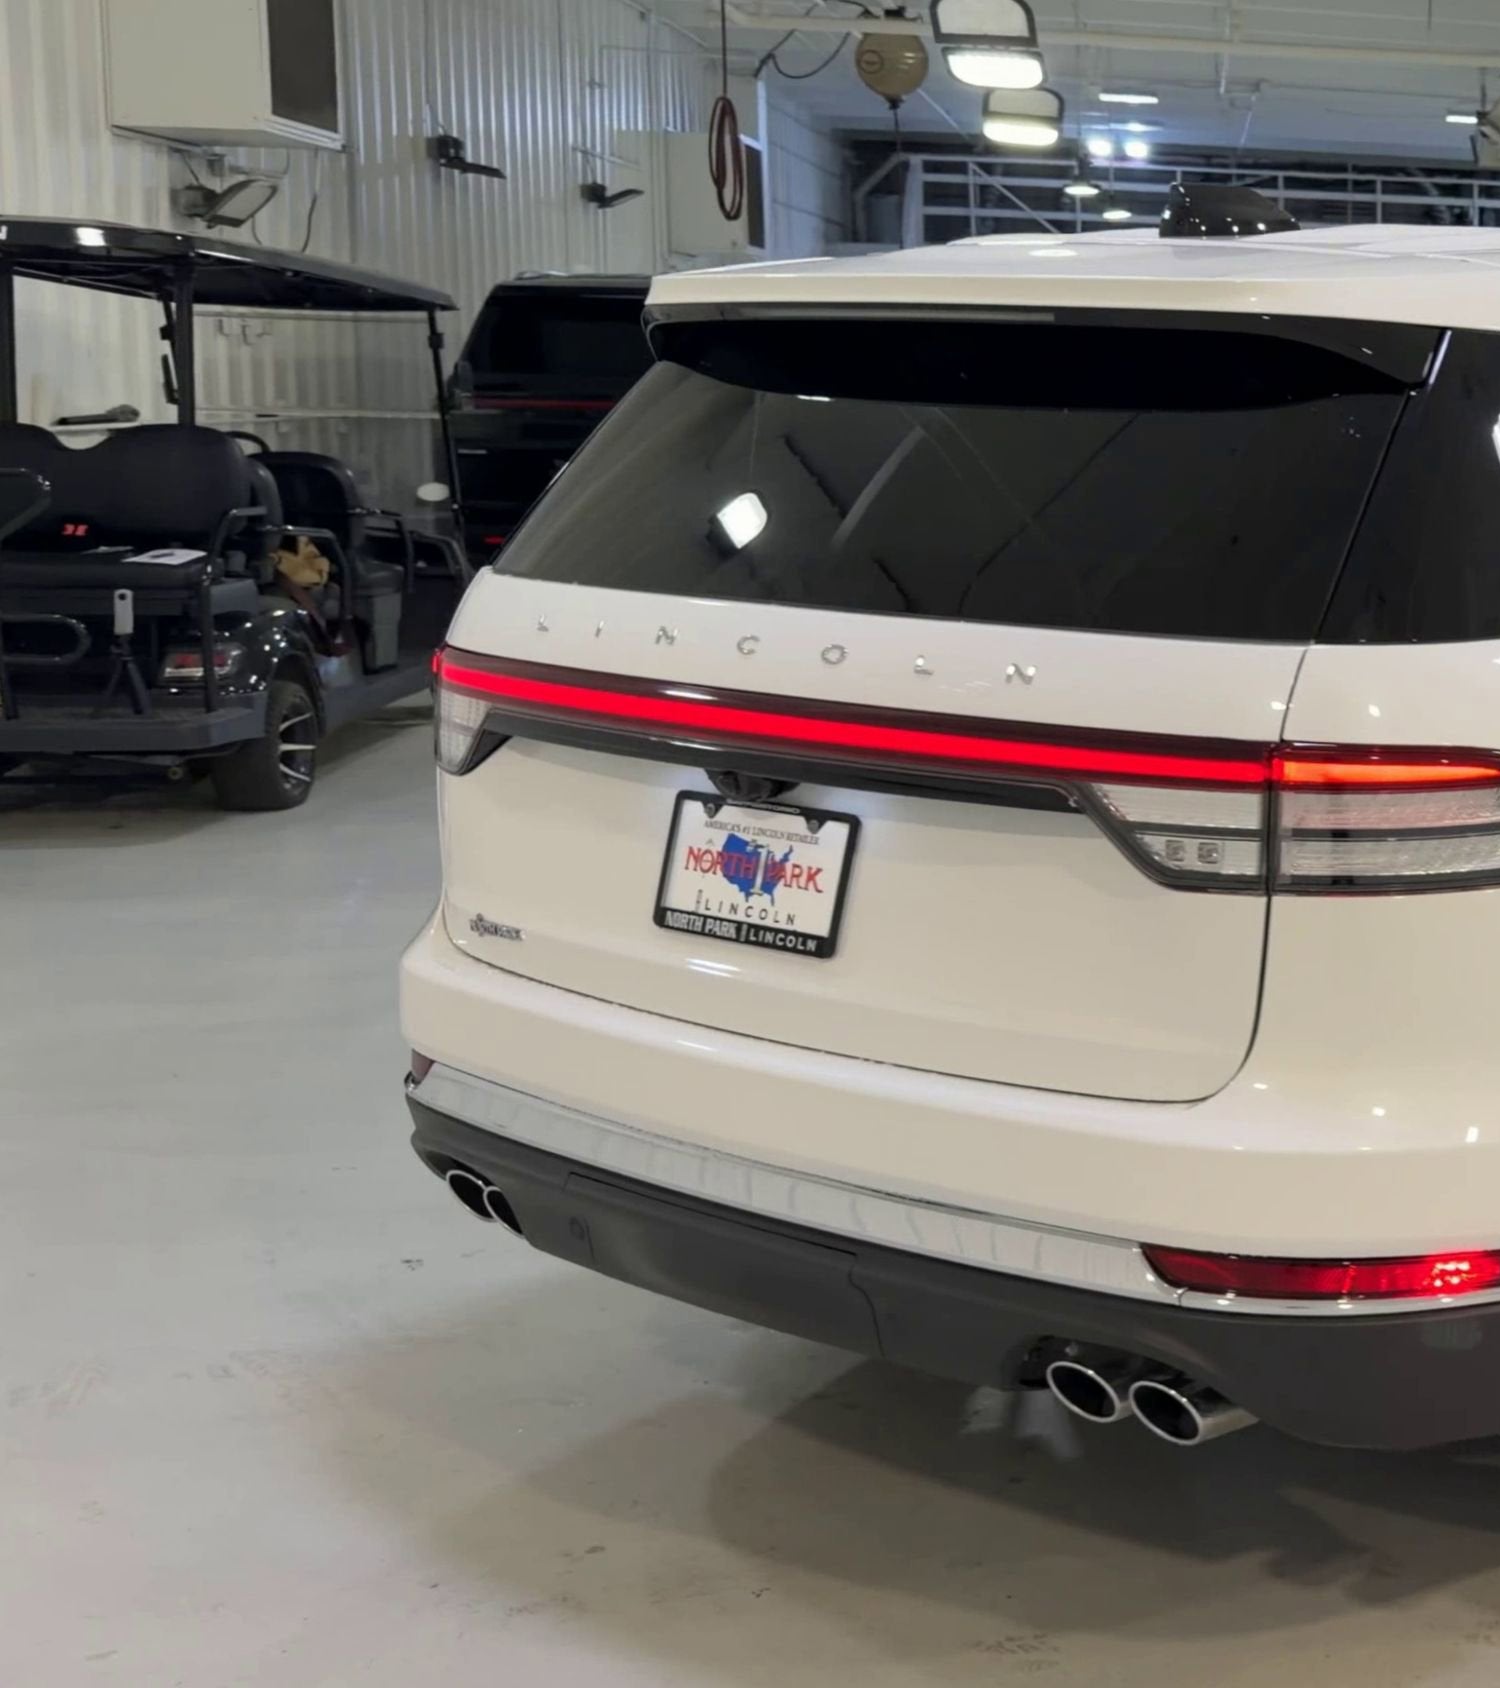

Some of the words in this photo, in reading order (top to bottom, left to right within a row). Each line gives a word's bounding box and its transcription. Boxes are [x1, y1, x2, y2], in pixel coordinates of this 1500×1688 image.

[537, 614, 1037, 686] LINCOLN
[752, 825, 785, 840] LINCOLN
[684, 846, 757, 880] NORTH
[767, 853, 824, 894] PARK
[664, 910, 704, 933] NORTH
[704, 917, 738, 940] PARK
[749, 922, 817, 952] LINCOLN
[704, 897, 796, 926] LINCOLN
